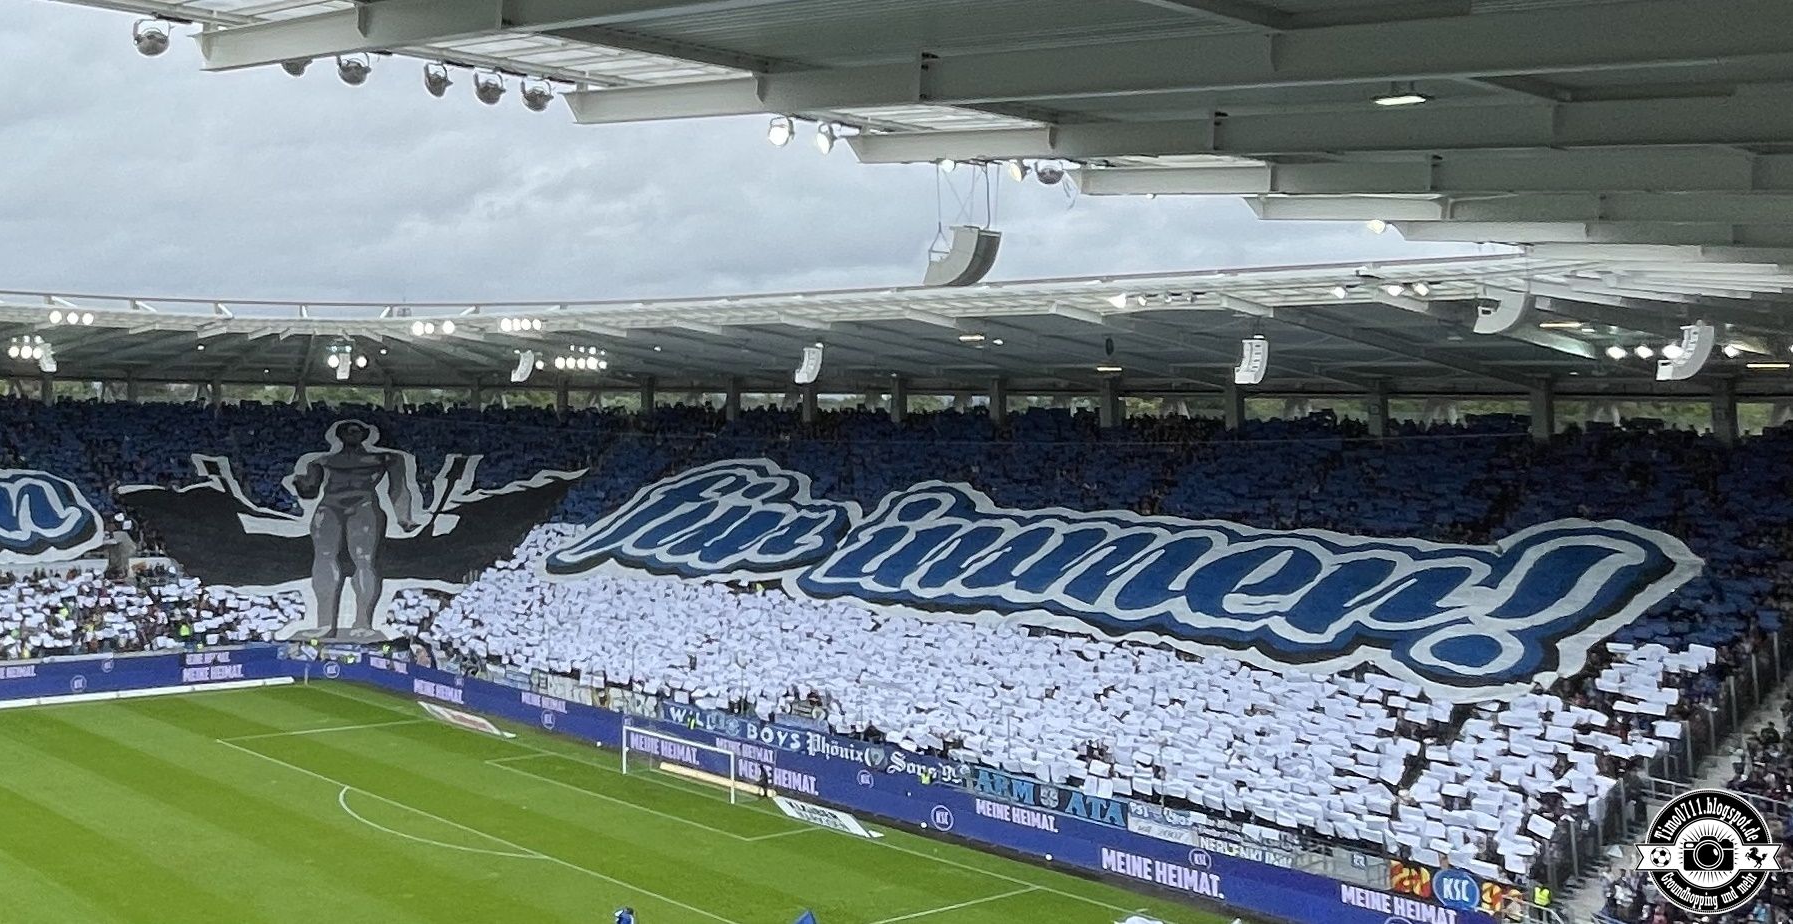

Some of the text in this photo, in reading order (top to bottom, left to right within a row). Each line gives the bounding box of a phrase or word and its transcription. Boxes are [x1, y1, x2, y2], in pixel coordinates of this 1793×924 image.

[747, 723, 802, 750] BOYS
[974, 770, 1035, 806] ARM
[1065, 791, 1126, 827] ATA
[975, 799, 1010, 821] MEINE
[1101, 848, 1225, 899] MEINE HEIMAT.
[1340, 884, 1392, 913] MEINE
[1442, 877, 1470, 902] KSC
